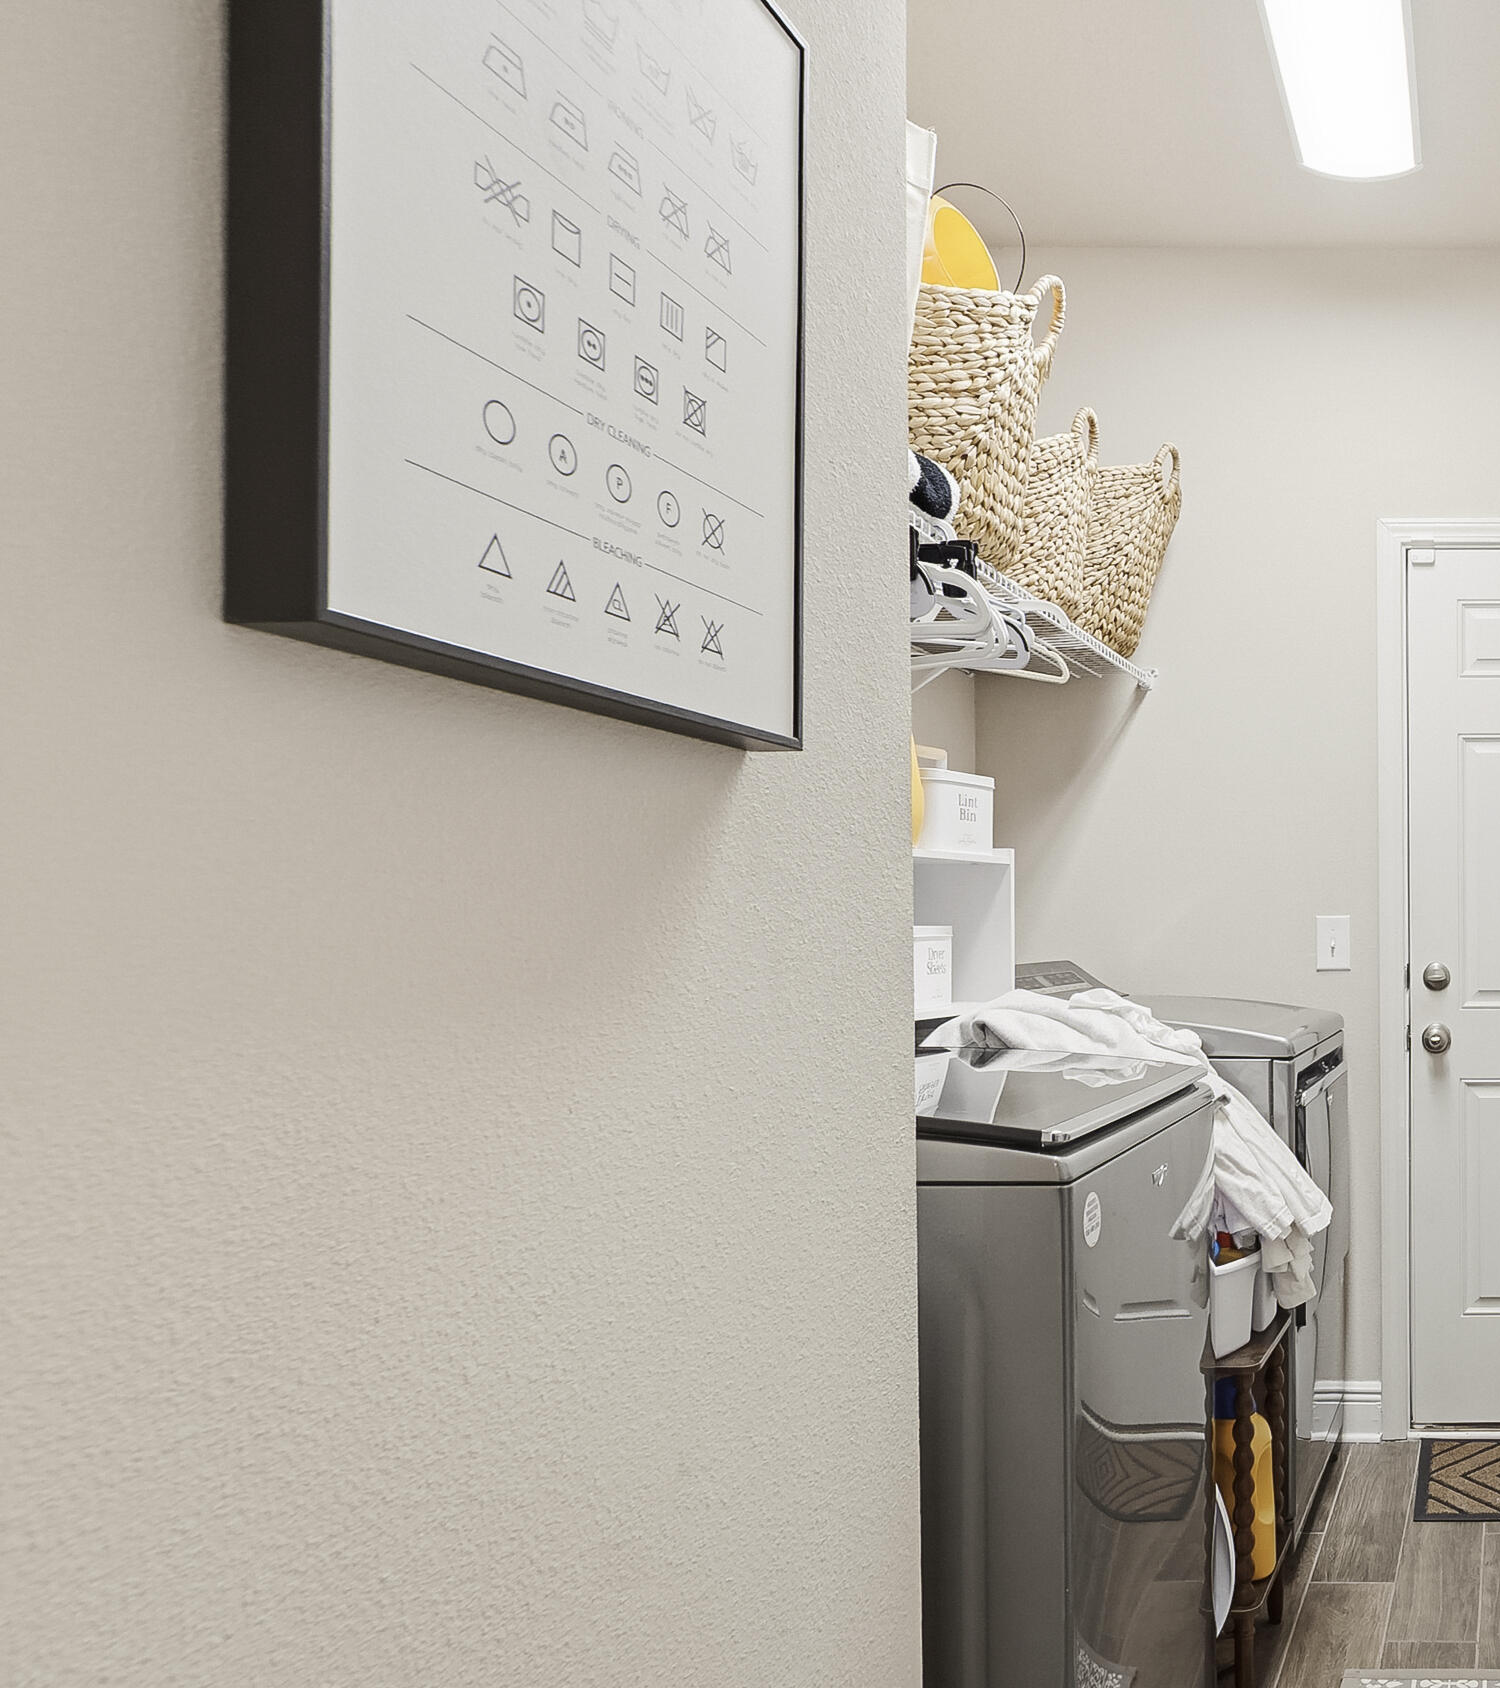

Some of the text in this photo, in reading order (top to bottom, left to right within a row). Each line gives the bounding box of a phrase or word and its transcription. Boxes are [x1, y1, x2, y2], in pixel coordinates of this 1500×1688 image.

[586, 412, 606, 432] DRY
[607, 425, 651, 458] CLEANING
[592, 536, 643, 568] BLEACHING
[958, 793, 978, 809] Lint
[959, 807, 977, 822] Bin
